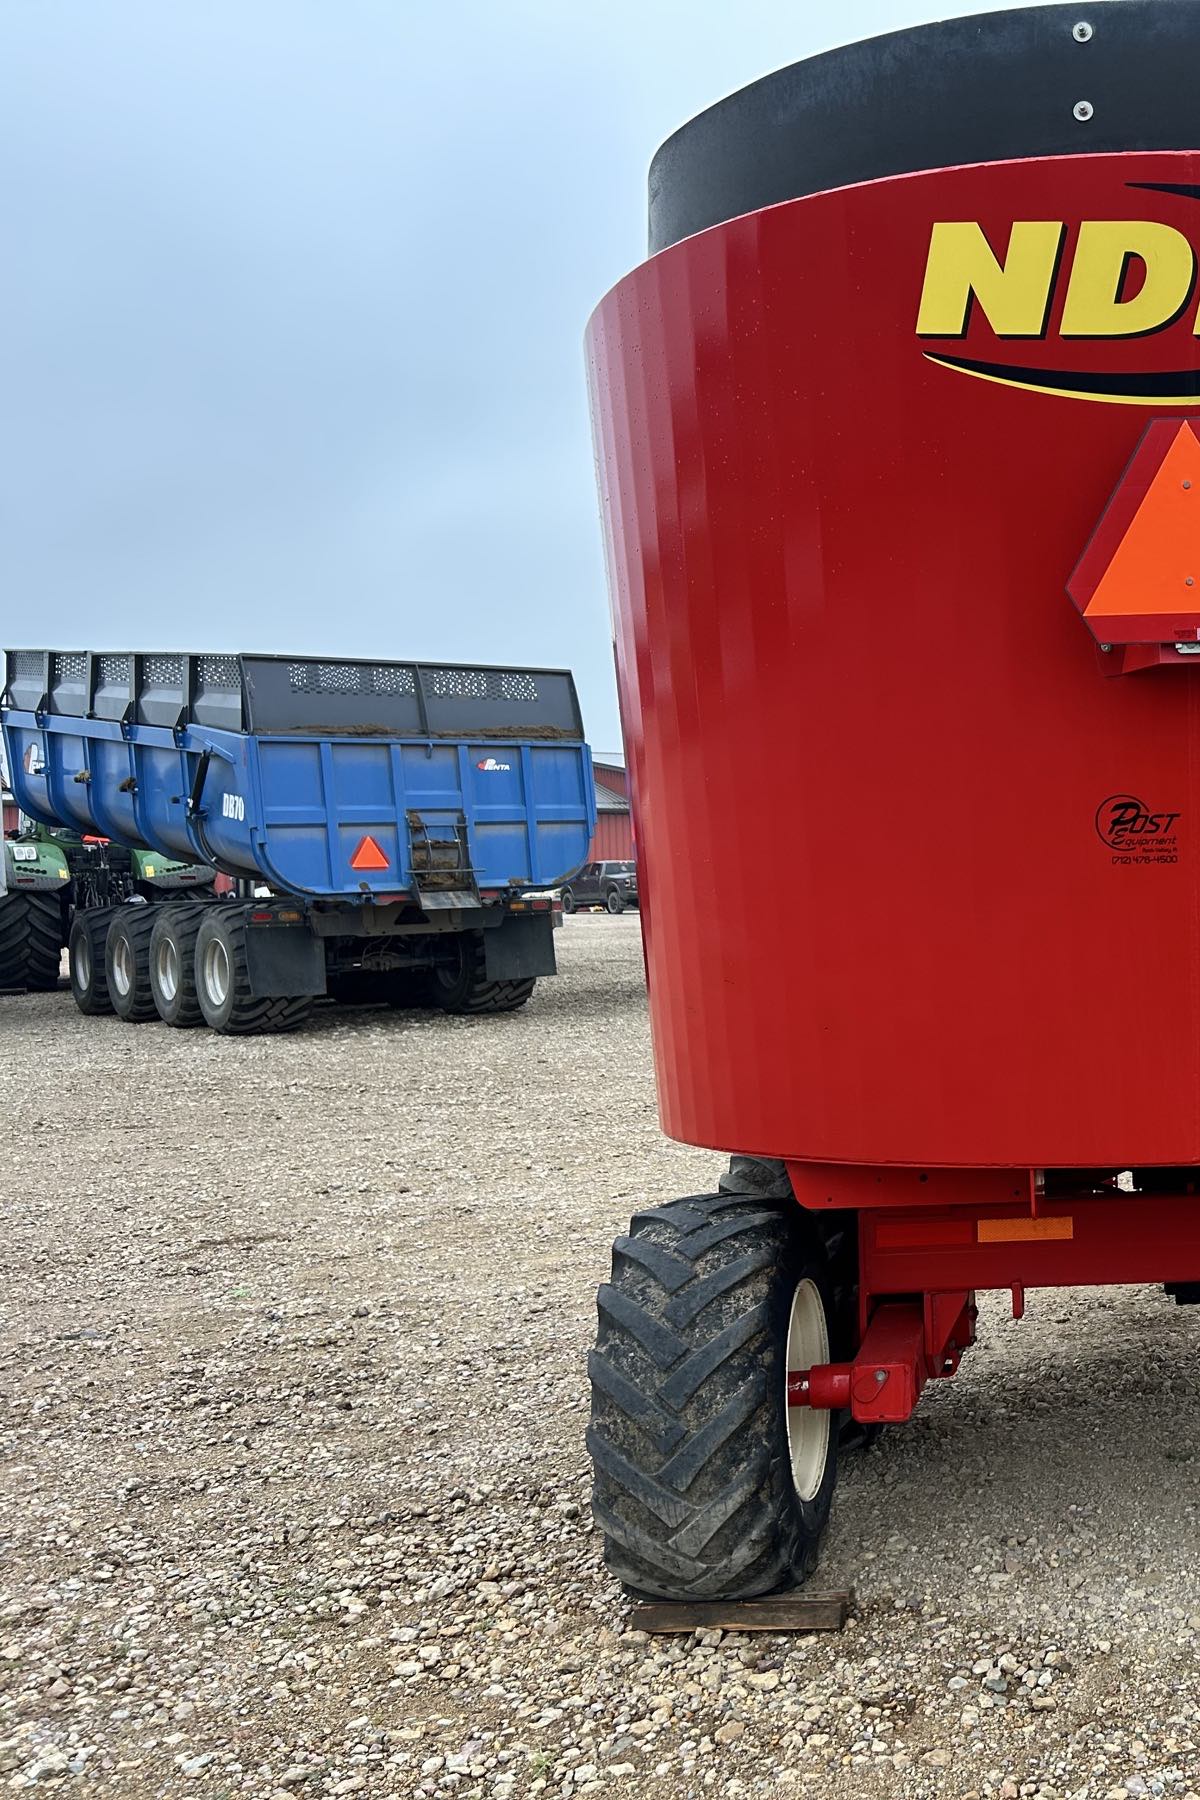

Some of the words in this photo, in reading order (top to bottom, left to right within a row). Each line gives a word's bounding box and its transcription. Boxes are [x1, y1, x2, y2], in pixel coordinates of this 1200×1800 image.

[222, 792, 245, 822] DB70
[1111, 827, 1177, 847] Equipment
[1111, 855, 1131, 864] (712)
[1133, 854, 1178, 864] 478-4500
